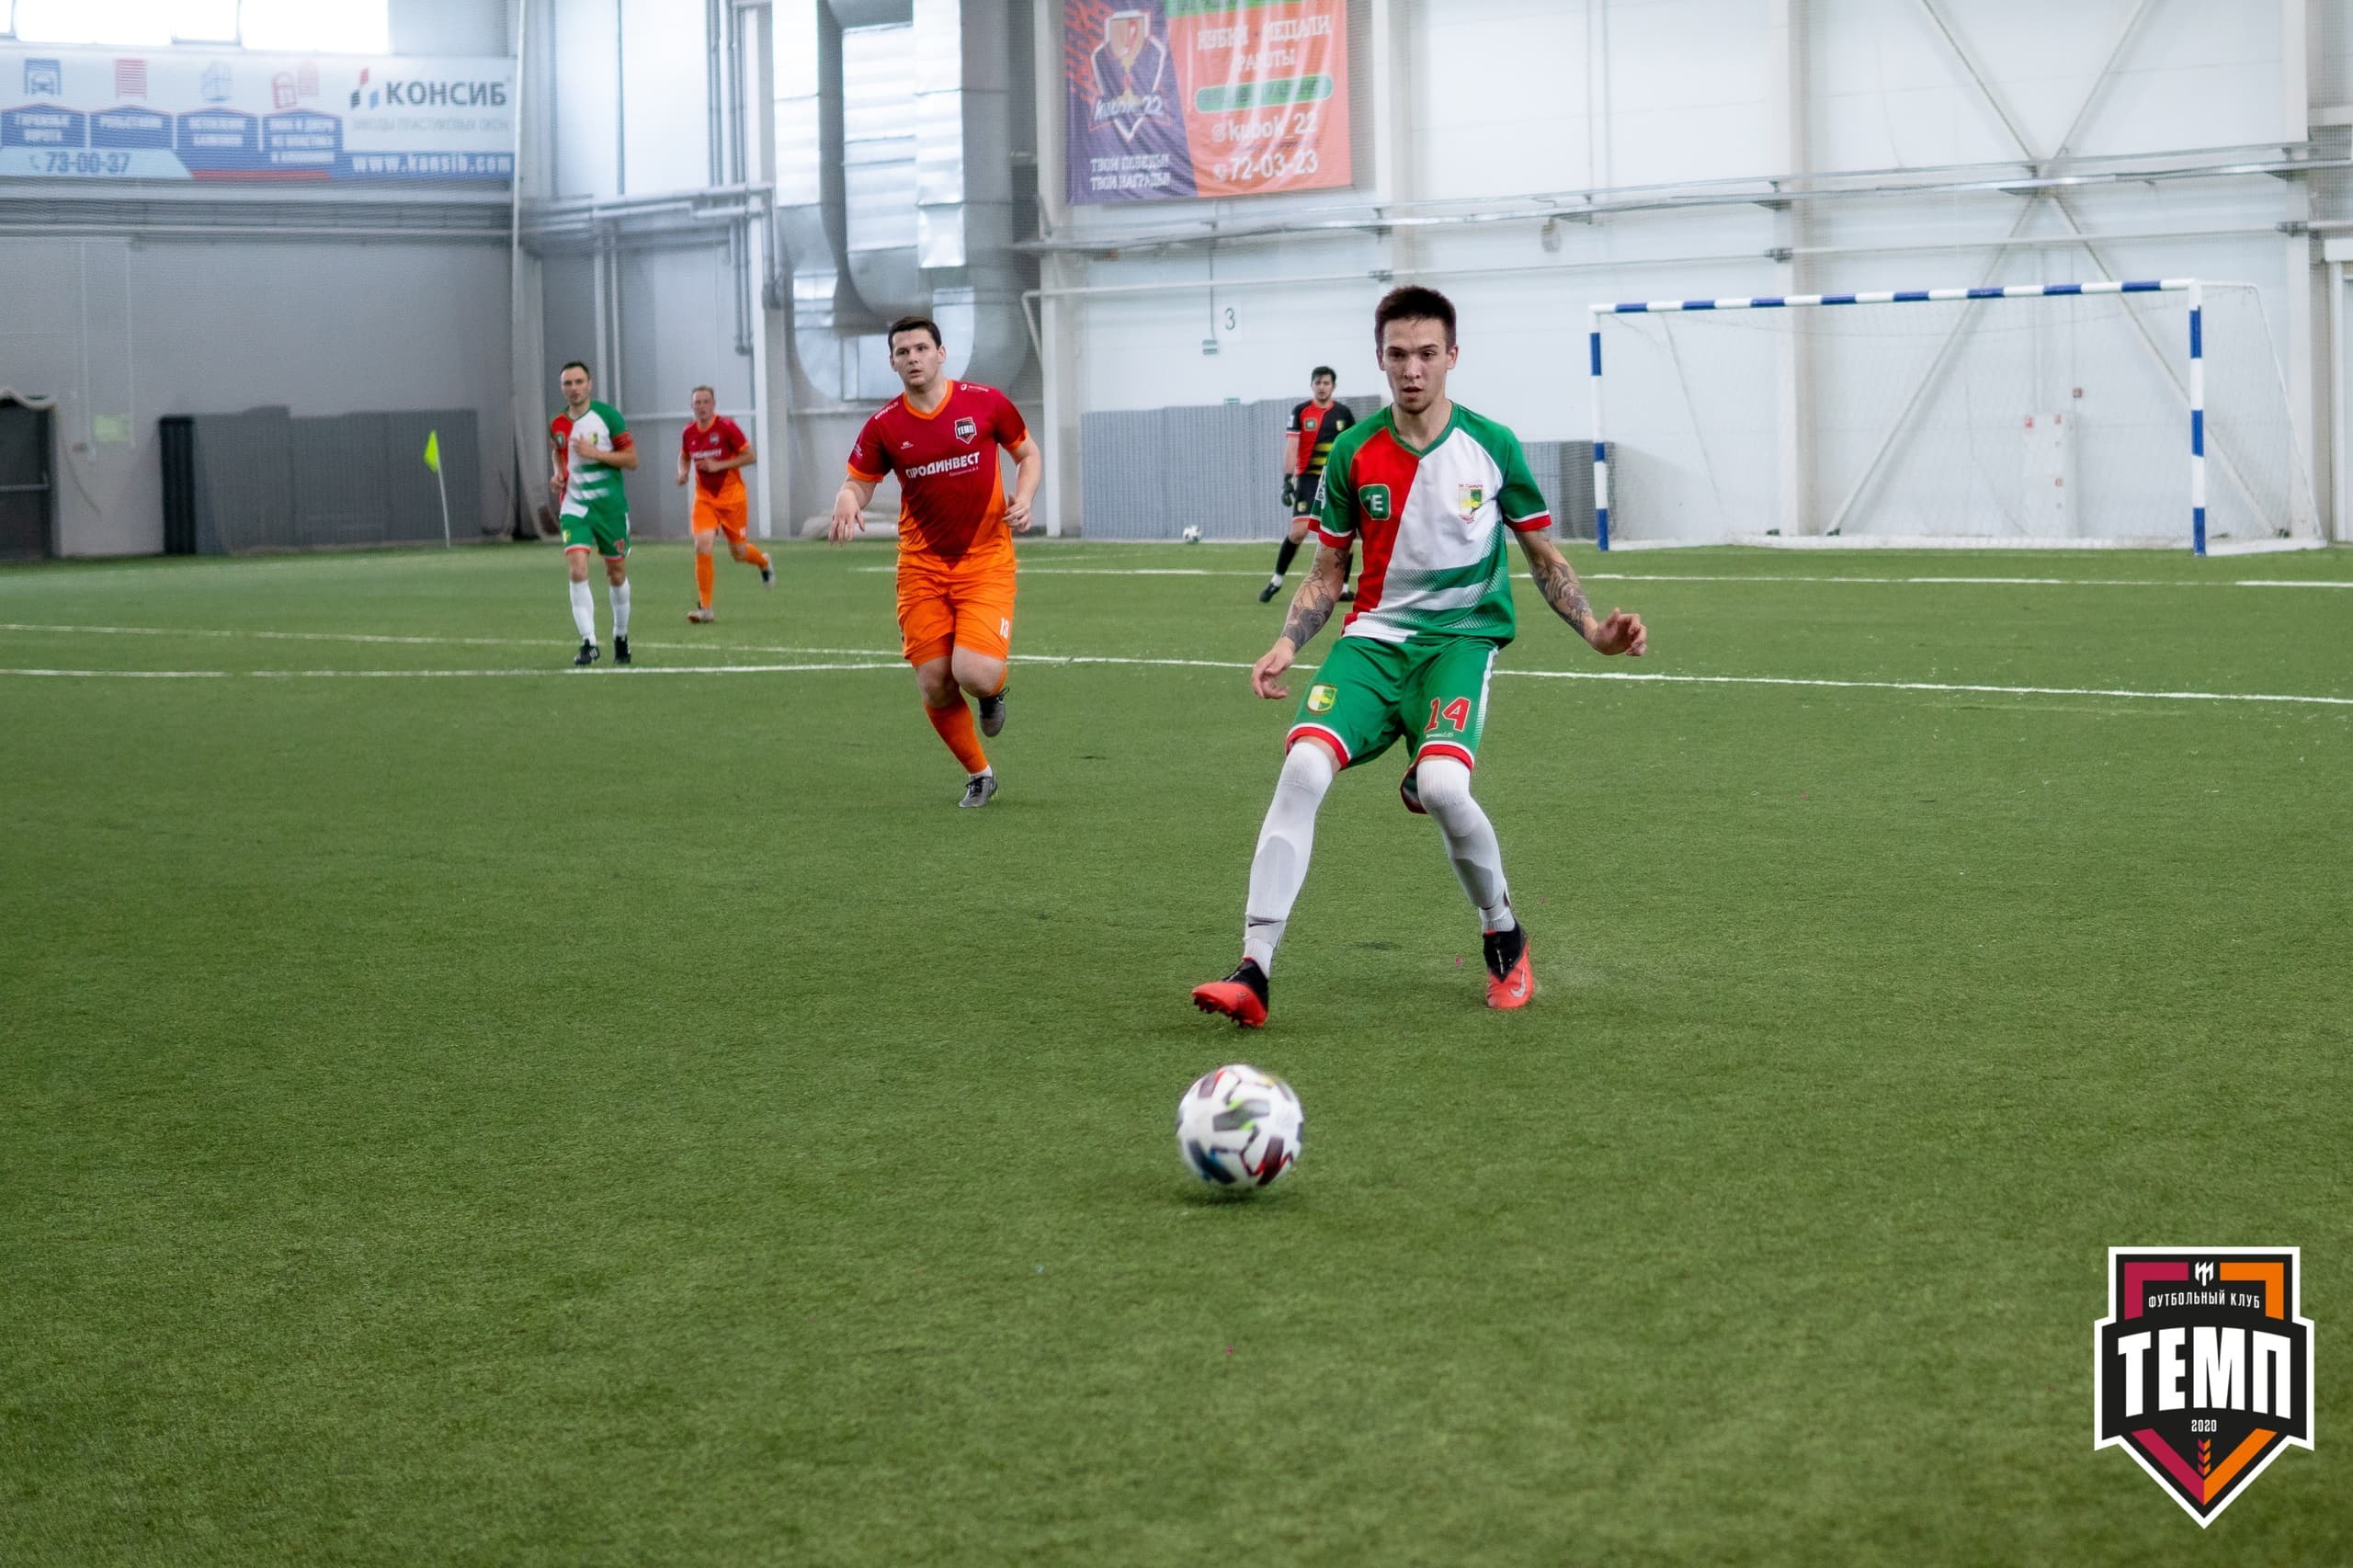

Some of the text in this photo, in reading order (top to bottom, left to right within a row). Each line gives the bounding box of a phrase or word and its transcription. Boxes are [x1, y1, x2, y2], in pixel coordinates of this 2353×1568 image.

[386, 81, 506, 106] КОНСИБ
[47, 152, 130, 173] 73-00-37
[352, 153, 512, 173] www.konsib.com
[1230, 149, 1319, 181] 72-03-23
[1224, 307, 1236, 331] 3
[905, 451, 981, 479] ПРОДИНВЕСТ
[1425, 697, 1472, 733] 14
